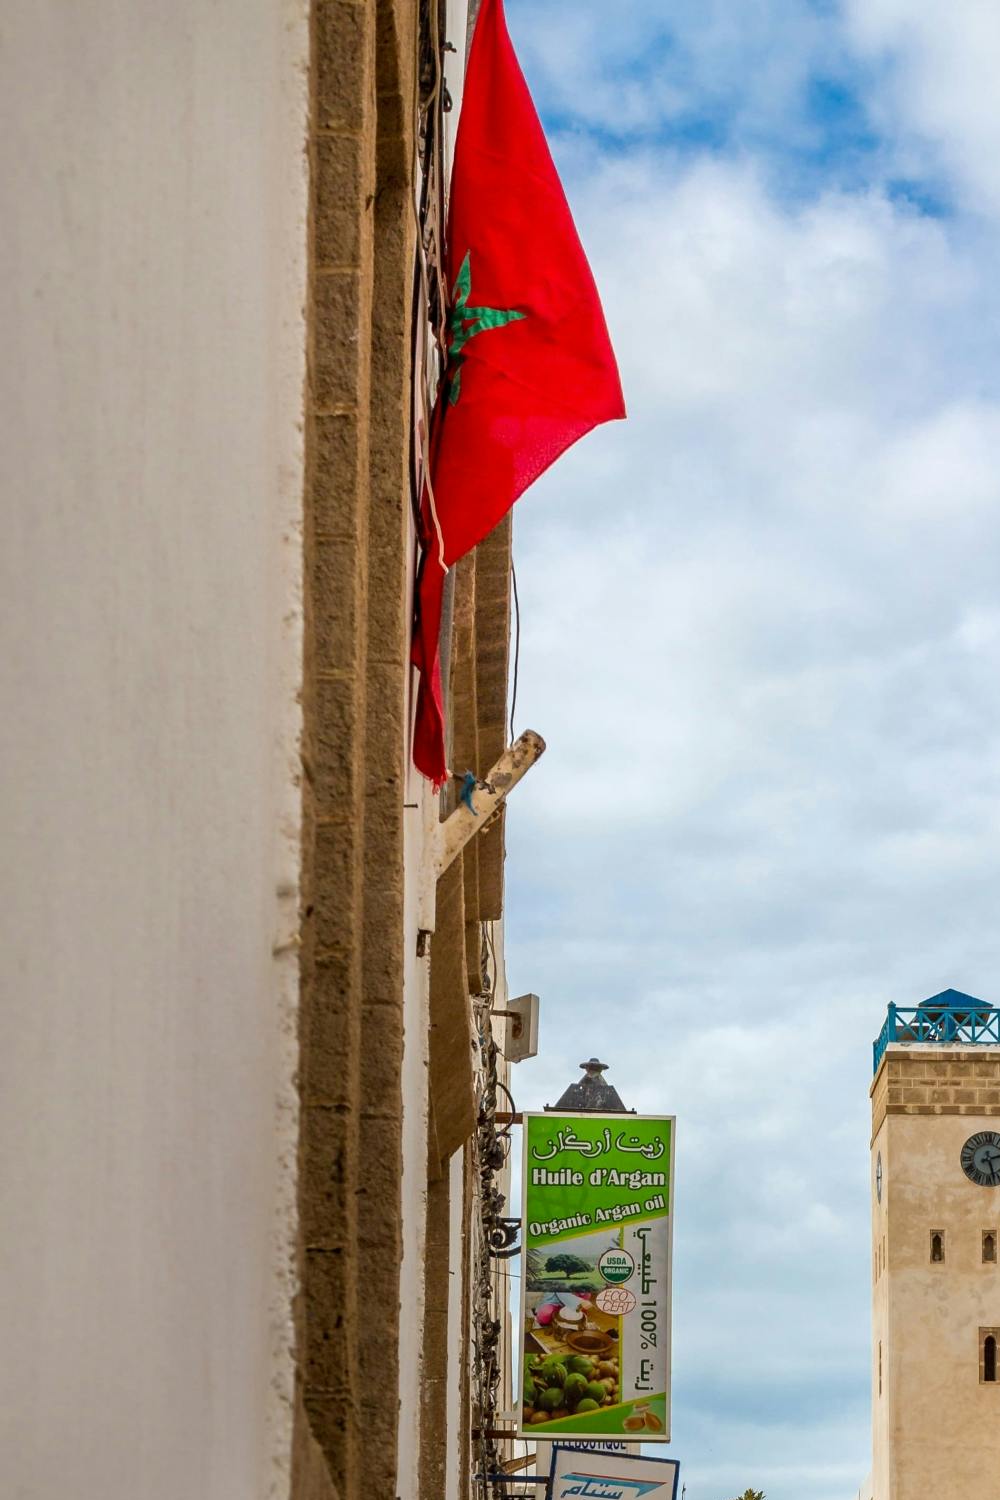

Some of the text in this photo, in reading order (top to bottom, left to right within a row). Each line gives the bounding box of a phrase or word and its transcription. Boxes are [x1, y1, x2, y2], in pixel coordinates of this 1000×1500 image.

[617, 1132, 665, 1159] زيت
[532, 1168, 583, 1185] Huile
[530, 1195, 665, 1236] Organic Argan oil
[606, 1257, 627, 1266] USDA
[603, 1267, 630, 1275] ORGANIC
[603, 1290, 629, 1301] ECO
[602, 1301, 632, 1312] CERT
